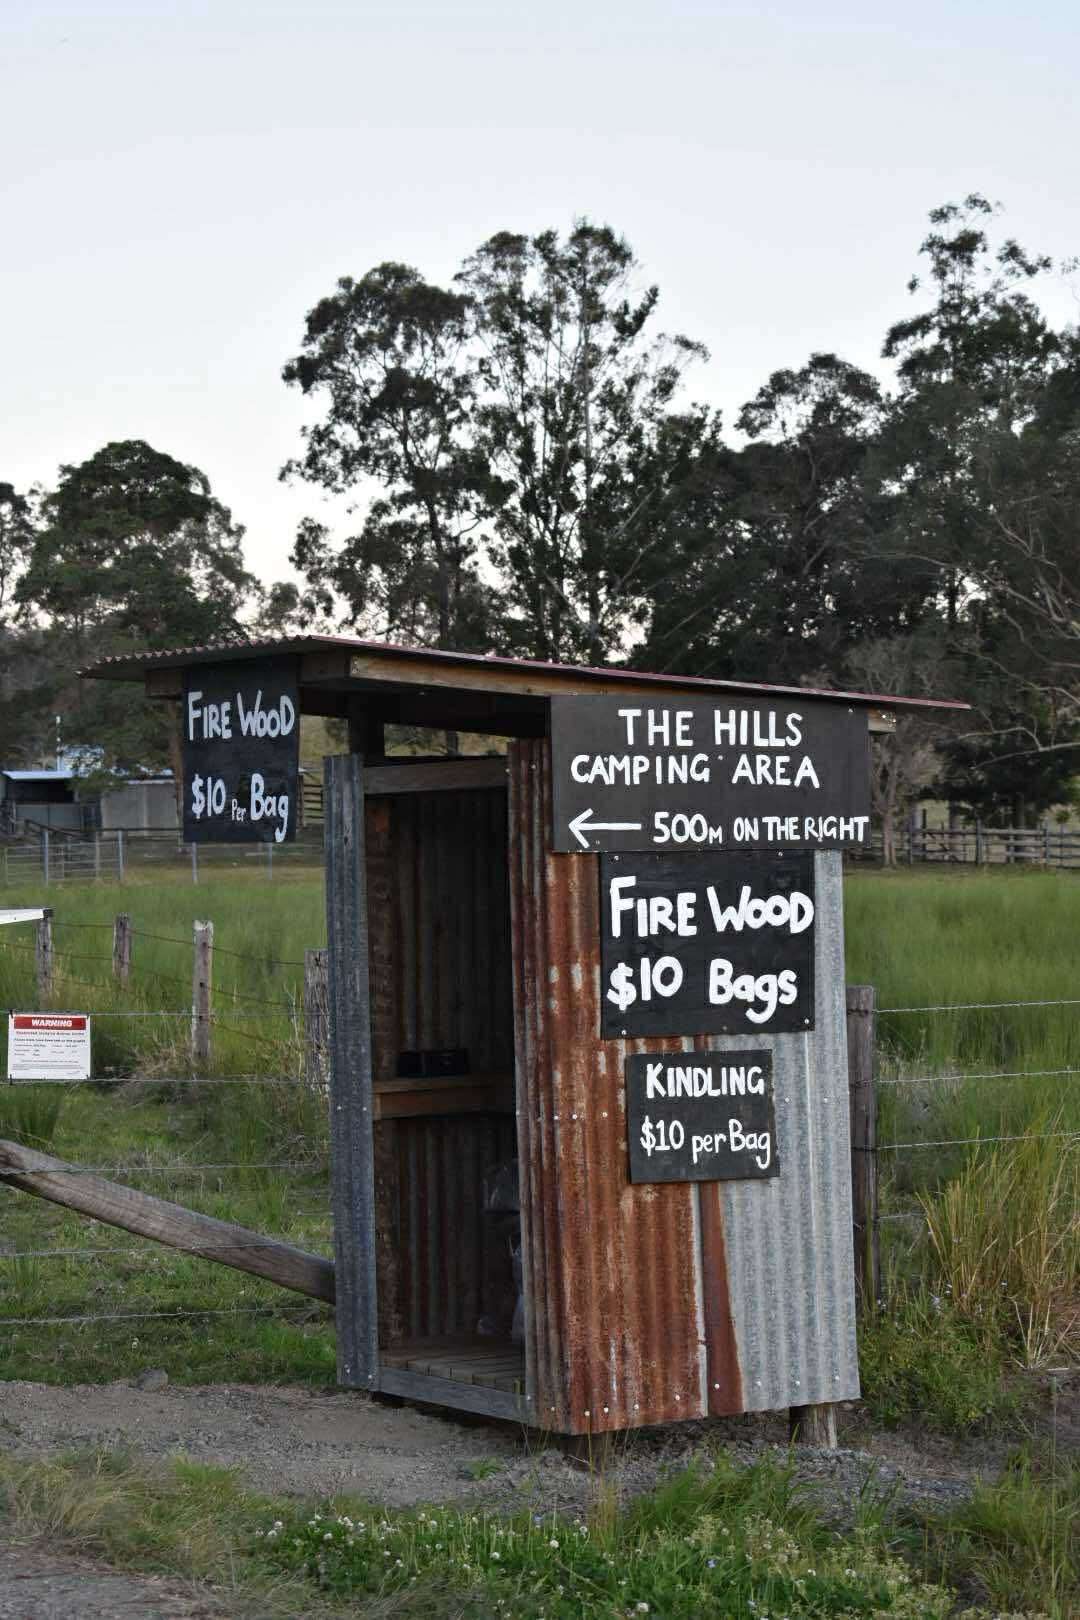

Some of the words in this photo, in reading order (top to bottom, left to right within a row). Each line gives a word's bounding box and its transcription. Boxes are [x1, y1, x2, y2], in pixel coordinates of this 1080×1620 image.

[188, 691, 233, 741] FIRE
[236, 689, 295, 738] WOOD
[618, 709, 694, 747] THE
[714, 709, 803, 747] HILLS
[570, 753, 711, 785] CAMPING
[731, 753, 820, 789] AREA
[191, 773, 226, 819] $10
[231, 798, 247, 822] Per
[250, 772, 289, 843] Bag
[733, 816, 760, 841] ON
[762, 816, 801, 841] THE
[803, 815, 869, 843] RIGHT
[609, 875, 698, 938] FIRE
[706, 885, 815, 934] WOOD
[606, 956, 684, 1012] $10
[709, 958, 798, 1024] Bags
[31, 1018, 72, 1027] WARNING
[646, 1062, 765, 1099] KINDLING
[639, 1115, 685, 1157] $10
[691, 1132, 727, 1164] per
[728, 1118, 771, 1170] Bag
